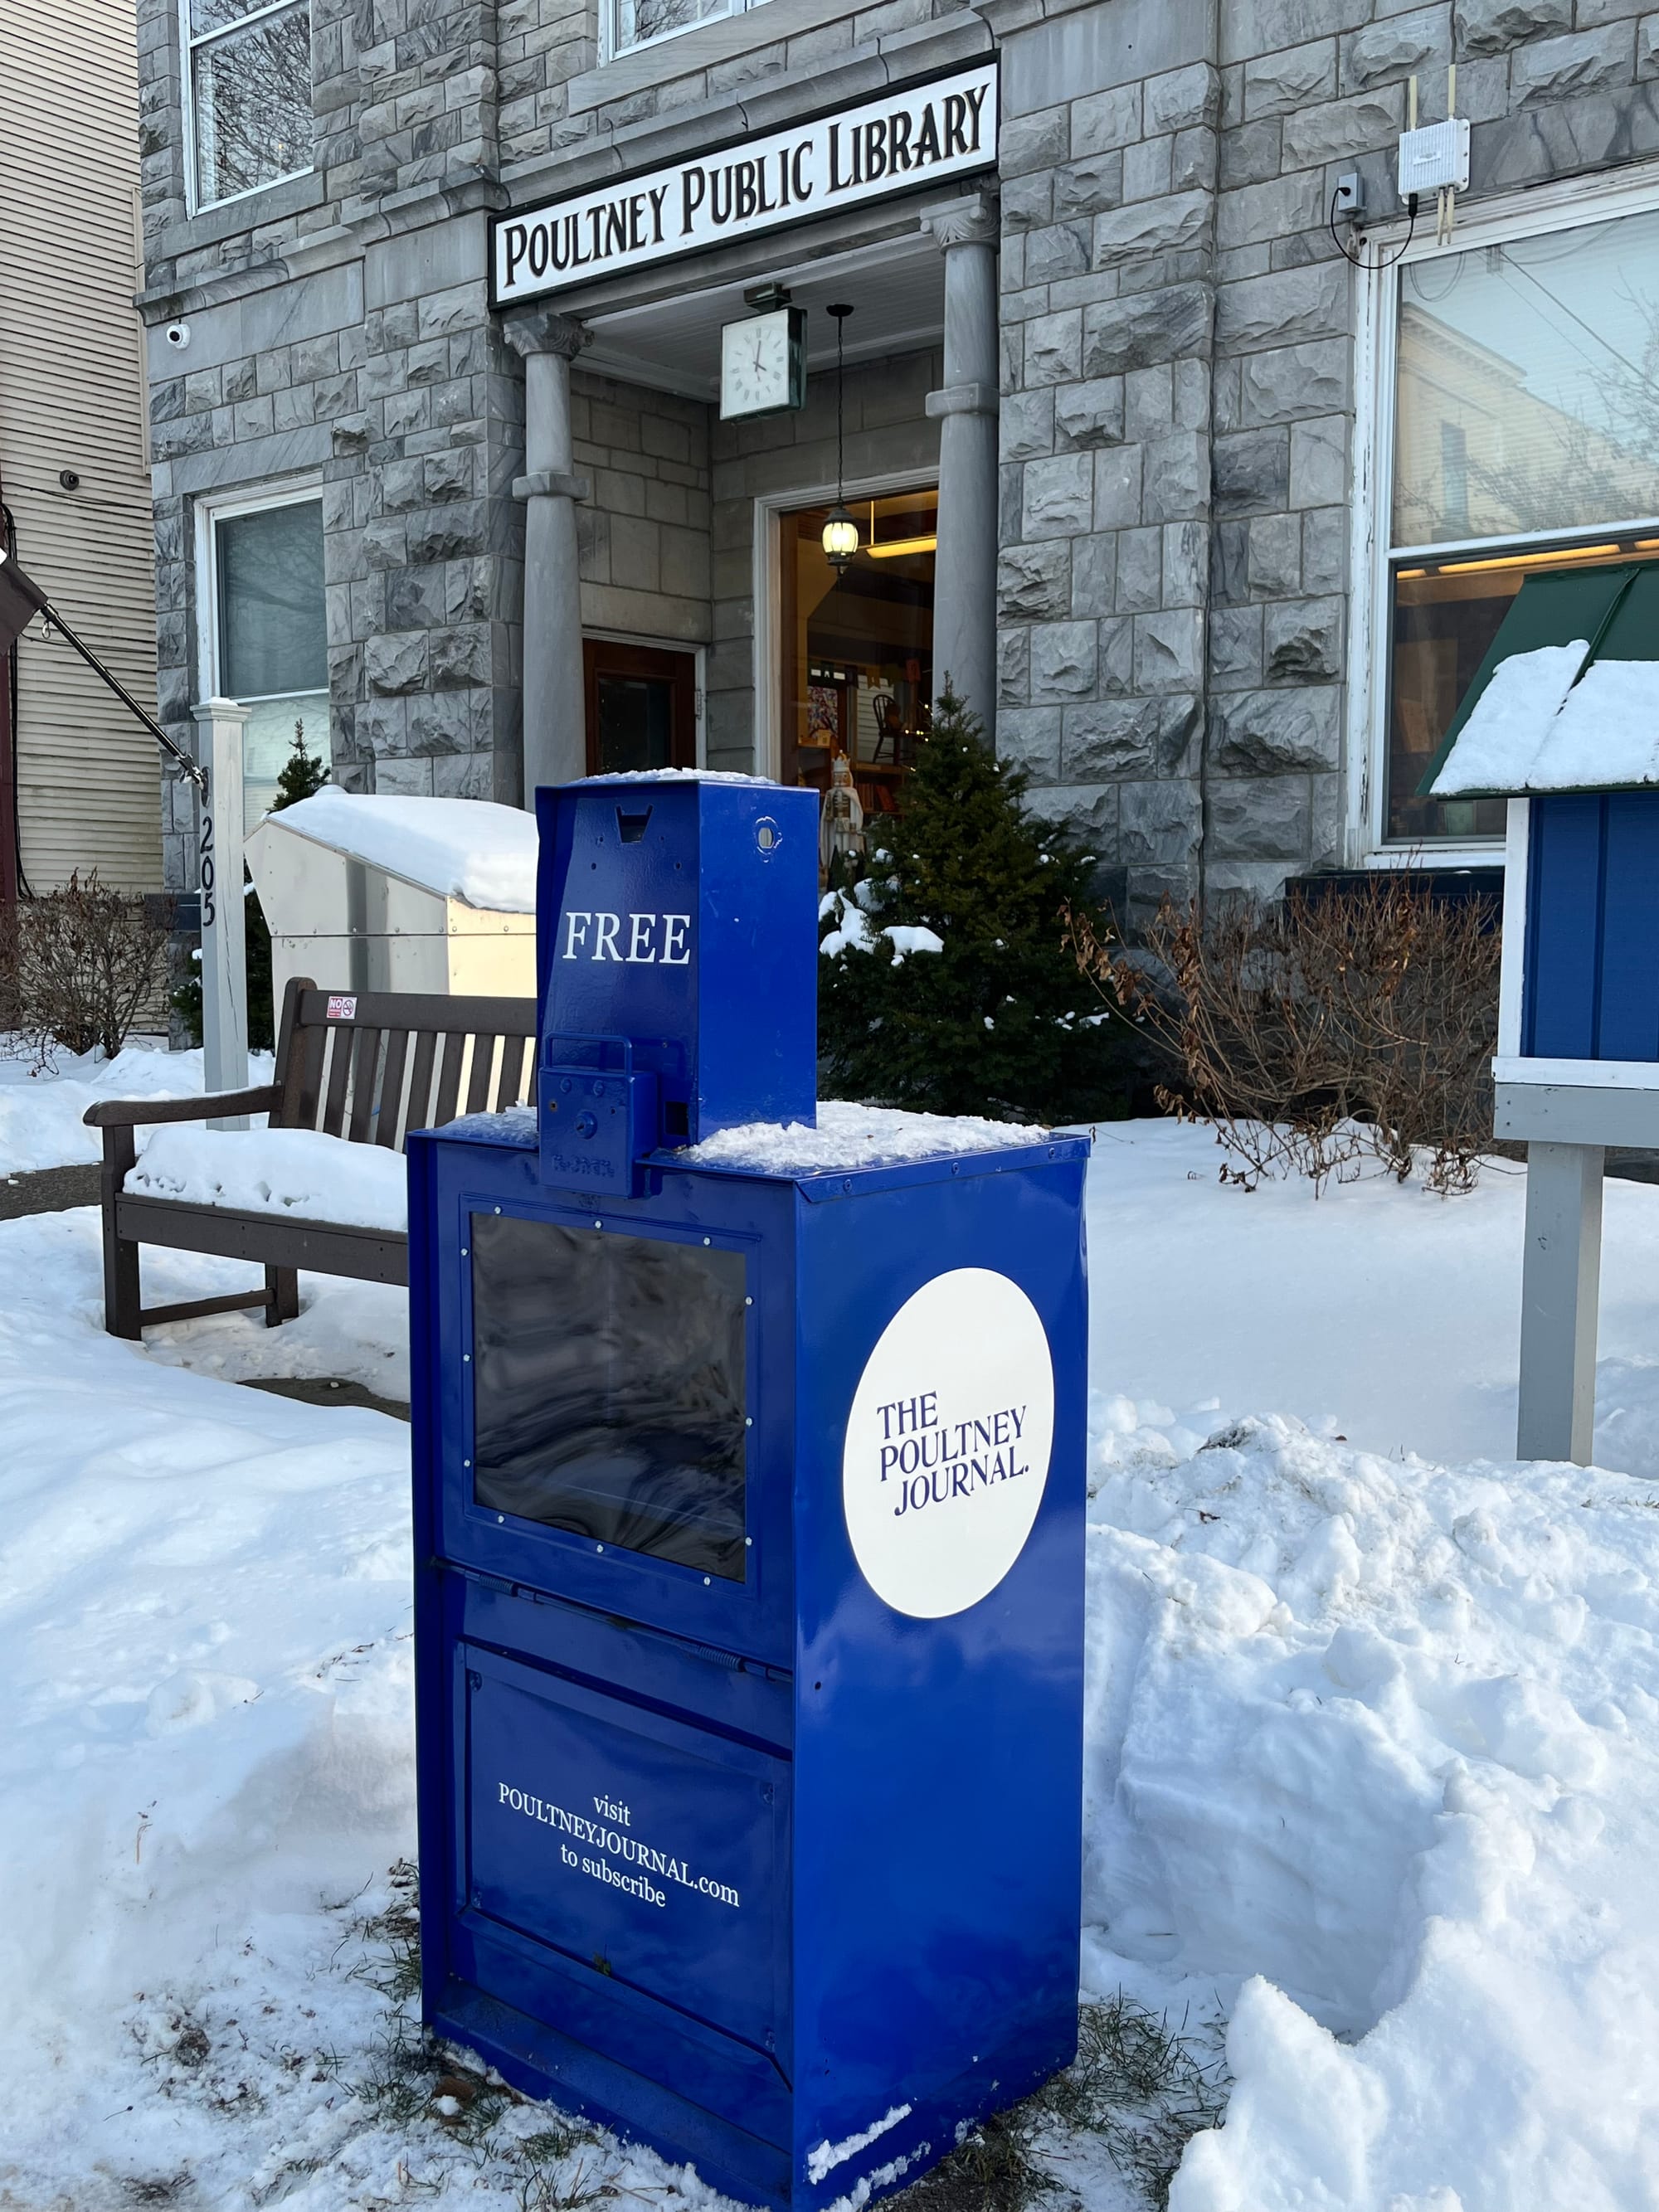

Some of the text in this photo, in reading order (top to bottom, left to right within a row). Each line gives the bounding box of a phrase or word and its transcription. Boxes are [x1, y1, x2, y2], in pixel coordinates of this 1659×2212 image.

[504, 83, 993, 289] POULTNEY PUBLIC LIBRARY
[200, 815, 216, 926] 205
[562, 912, 691, 965] FREE
[329, 998, 343, 1009] NO
[876, 1390, 939, 1440] THE
[880, 1405, 1027, 1482] POULTNEY
[893, 1446, 1029, 1516] JOURNAL.
[593, 1794, 631, 1826] visit
[498, 1782, 740, 1908] POULTNEYJOURNAL.com
[560, 1843, 666, 1908] to subscribe
